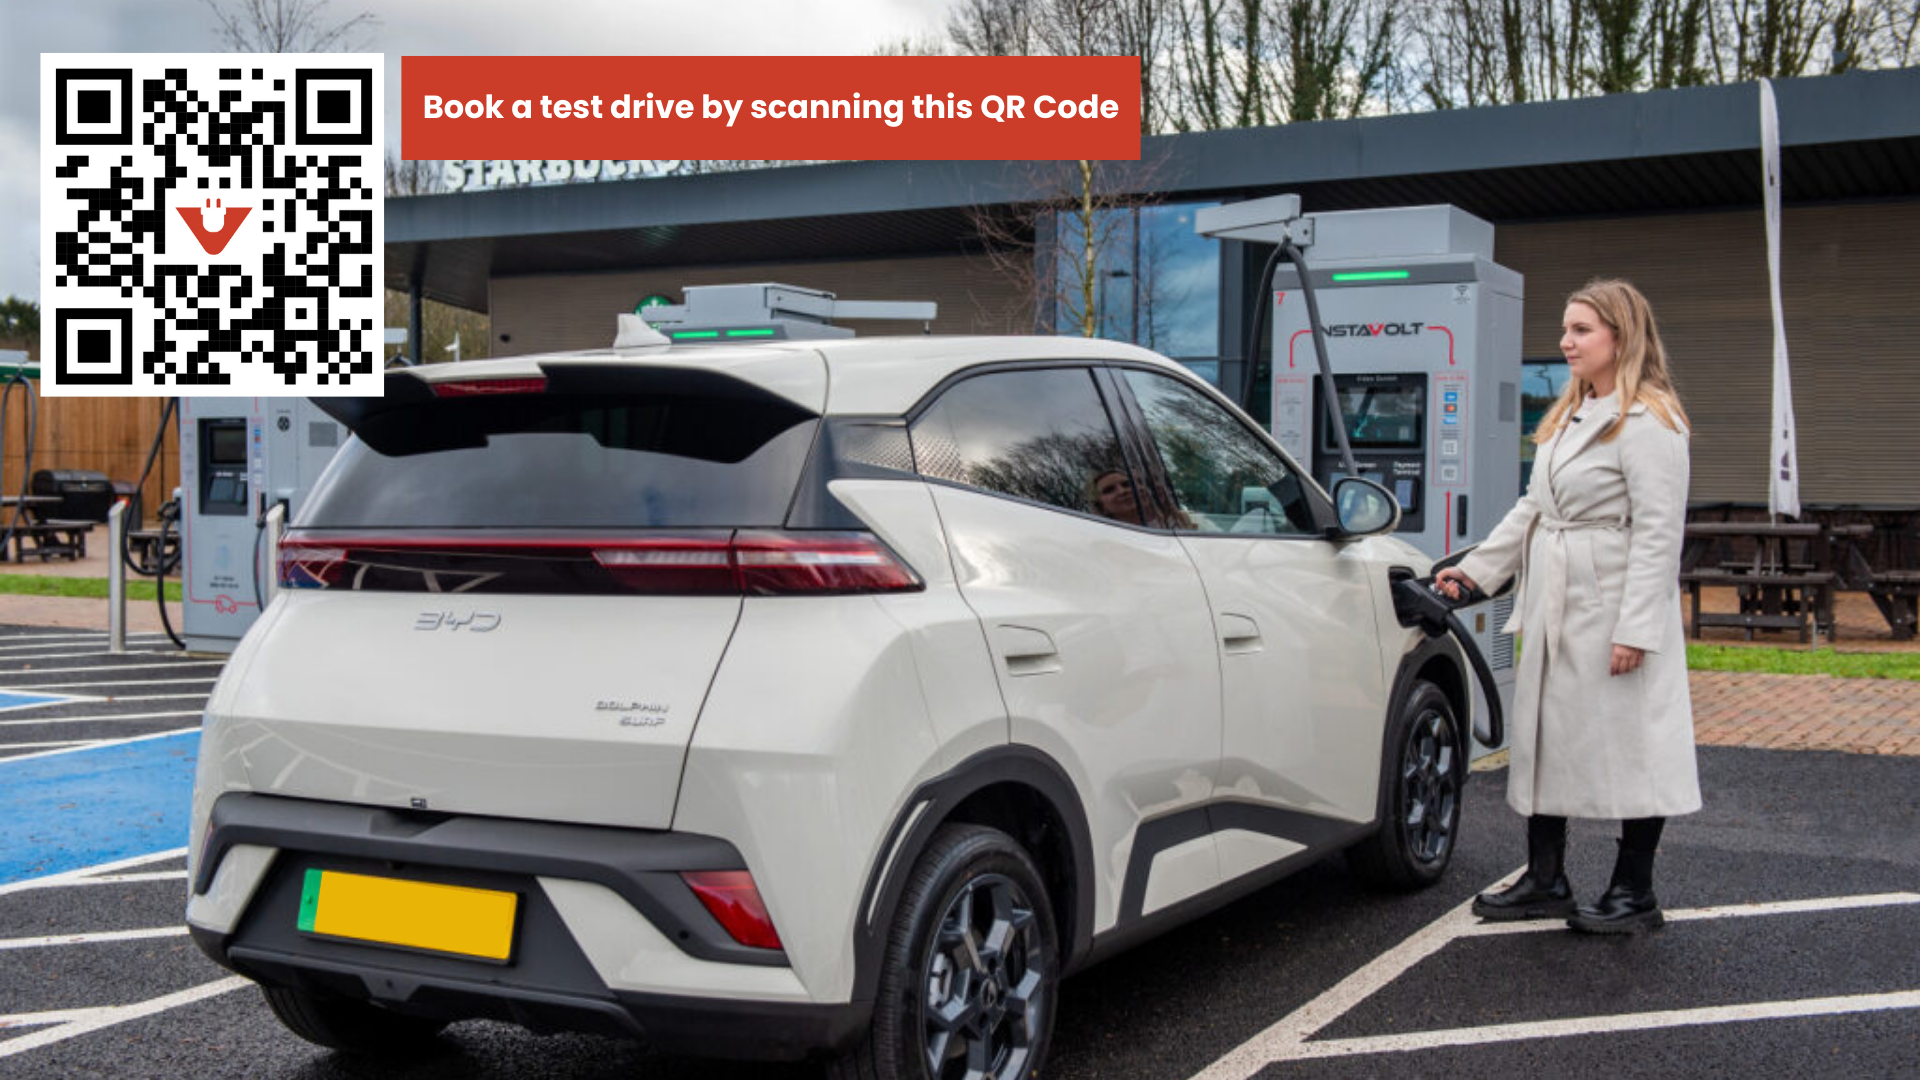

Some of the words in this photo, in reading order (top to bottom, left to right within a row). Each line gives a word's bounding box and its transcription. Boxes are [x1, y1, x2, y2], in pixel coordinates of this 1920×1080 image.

[1276, 292, 1285, 305] 7
[1318, 321, 1424, 337] NSTAVOLT
[413, 611, 502, 632] BYD
[595, 701, 670, 713] DOLPHIN
[619, 717, 666, 727] SURF
